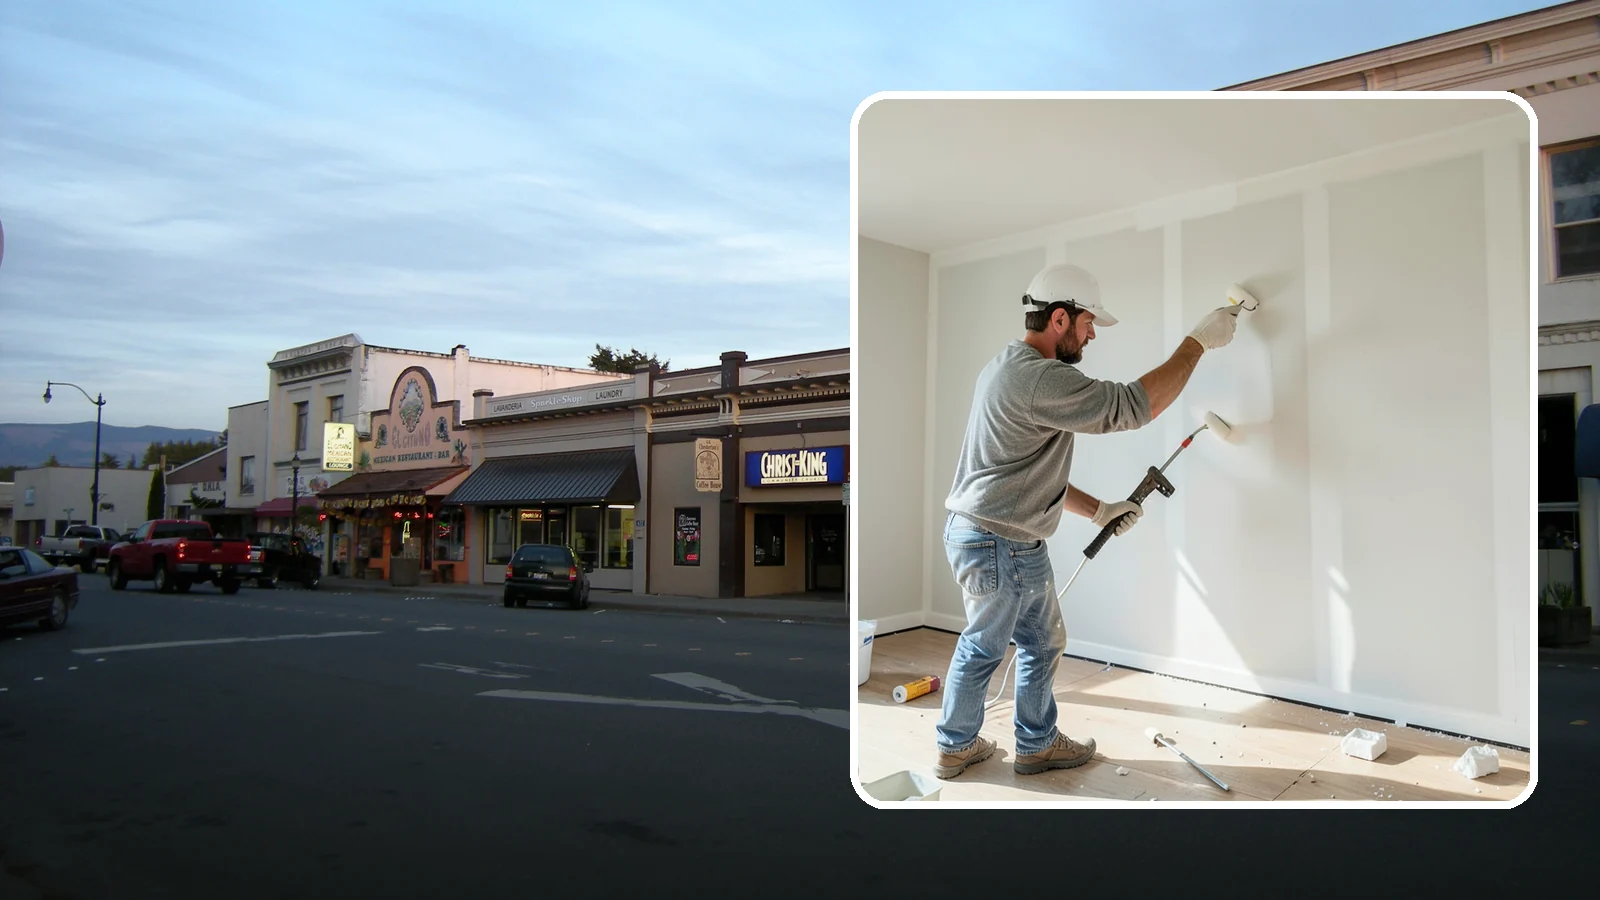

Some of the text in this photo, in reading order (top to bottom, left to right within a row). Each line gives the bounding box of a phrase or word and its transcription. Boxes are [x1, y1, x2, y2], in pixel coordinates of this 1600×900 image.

[595, 389, 624, 400] LAUNDRY
[493, 402, 522, 413] LAVANDERIA
[530, 394, 582, 409] Sparkle Shop
[397, 451, 434, 462] RESTAURANT
[438, 450, 450, 459] BAR
[760, 450, 827, 478] CHRIST KING
